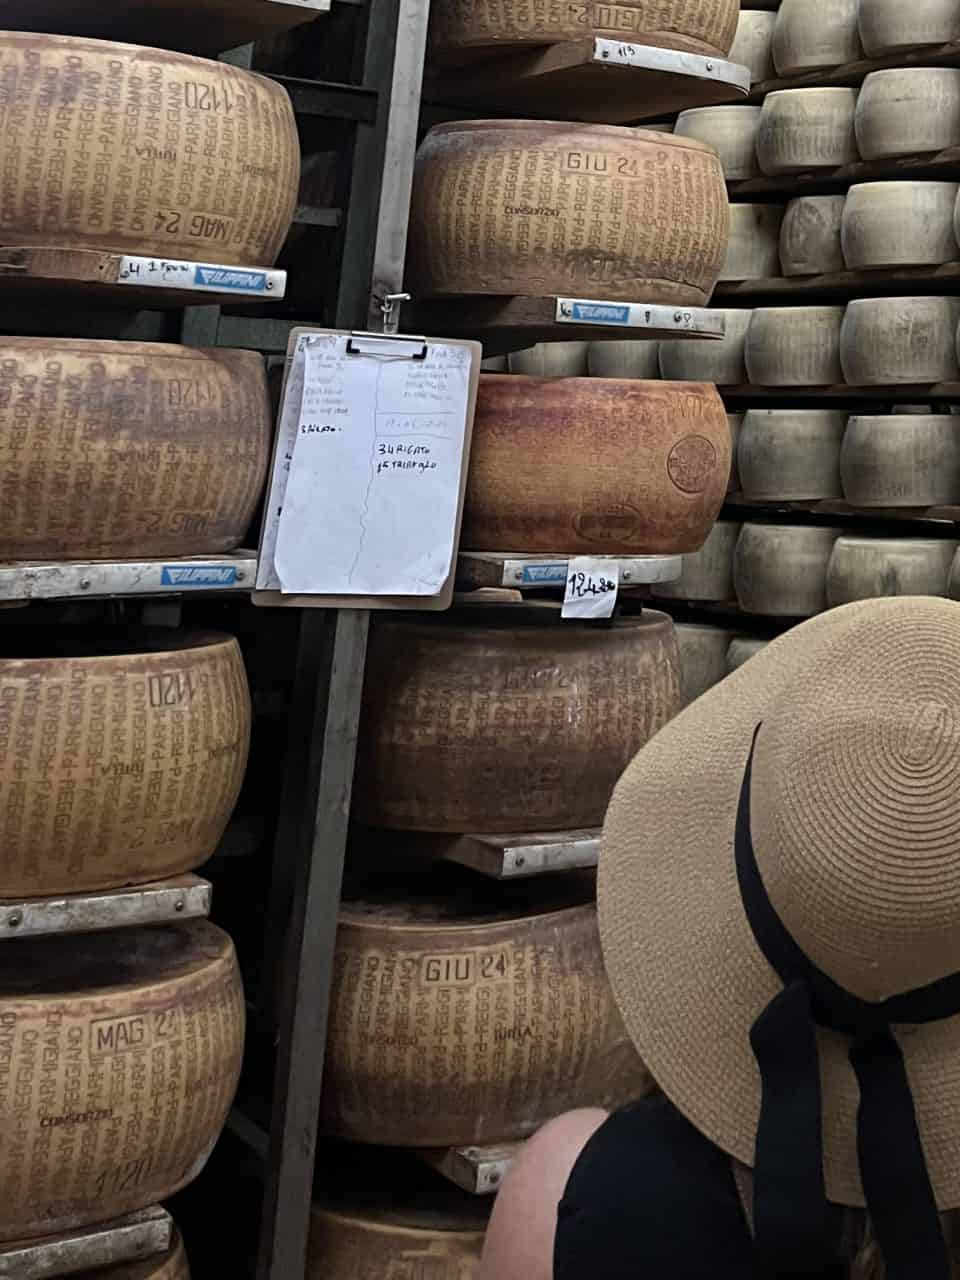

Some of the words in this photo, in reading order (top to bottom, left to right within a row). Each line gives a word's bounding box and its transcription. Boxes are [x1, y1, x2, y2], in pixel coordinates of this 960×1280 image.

[184, 81, 231, 114] 1120
[566, 152, 608, 172] GIU
[154, 211, 181, 234] 24
[189, 215, 231, 241] MAG
[149, 673, 192, 707] 1120
[425, 958, 471, 982] GIU
[97, 1019, 144, 1051] MAG
